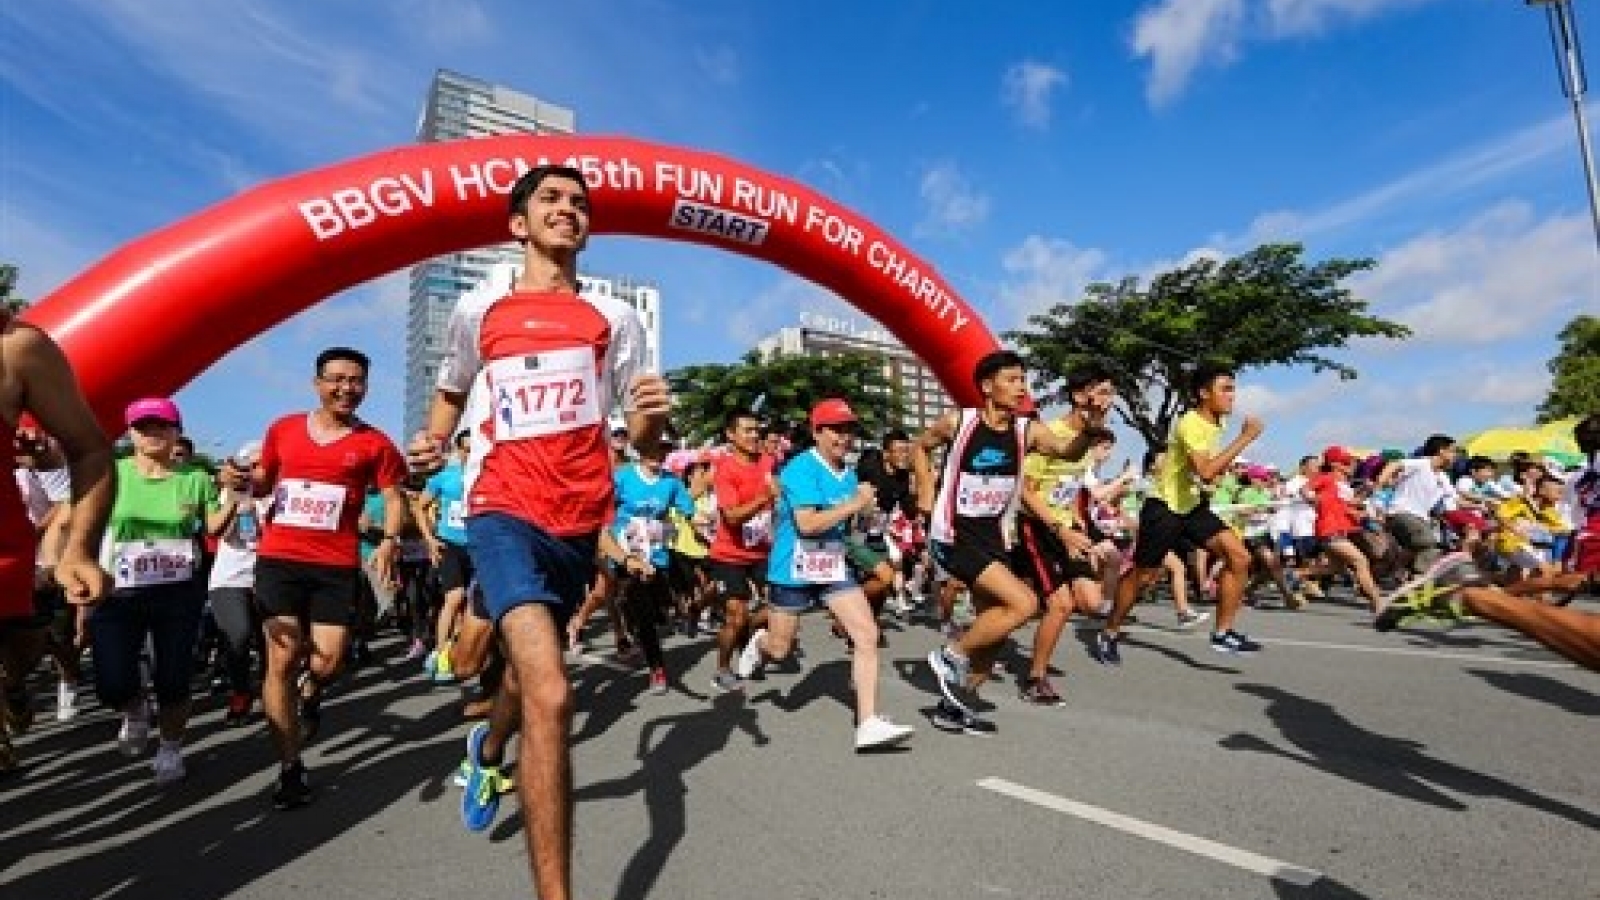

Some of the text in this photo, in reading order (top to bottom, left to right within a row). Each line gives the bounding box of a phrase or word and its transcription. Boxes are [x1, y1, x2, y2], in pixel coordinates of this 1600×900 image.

[676, 206, 764, 242] START
[298, 168, 435, 240] BBGV
[655, 163, 722, 204] FUN
[734, 179, 798, 224] RUN
[805, 206, 864, 254] FOR
[868, 241, 969, 332] CHARITY
[514, 378, 587, 415] 1772
